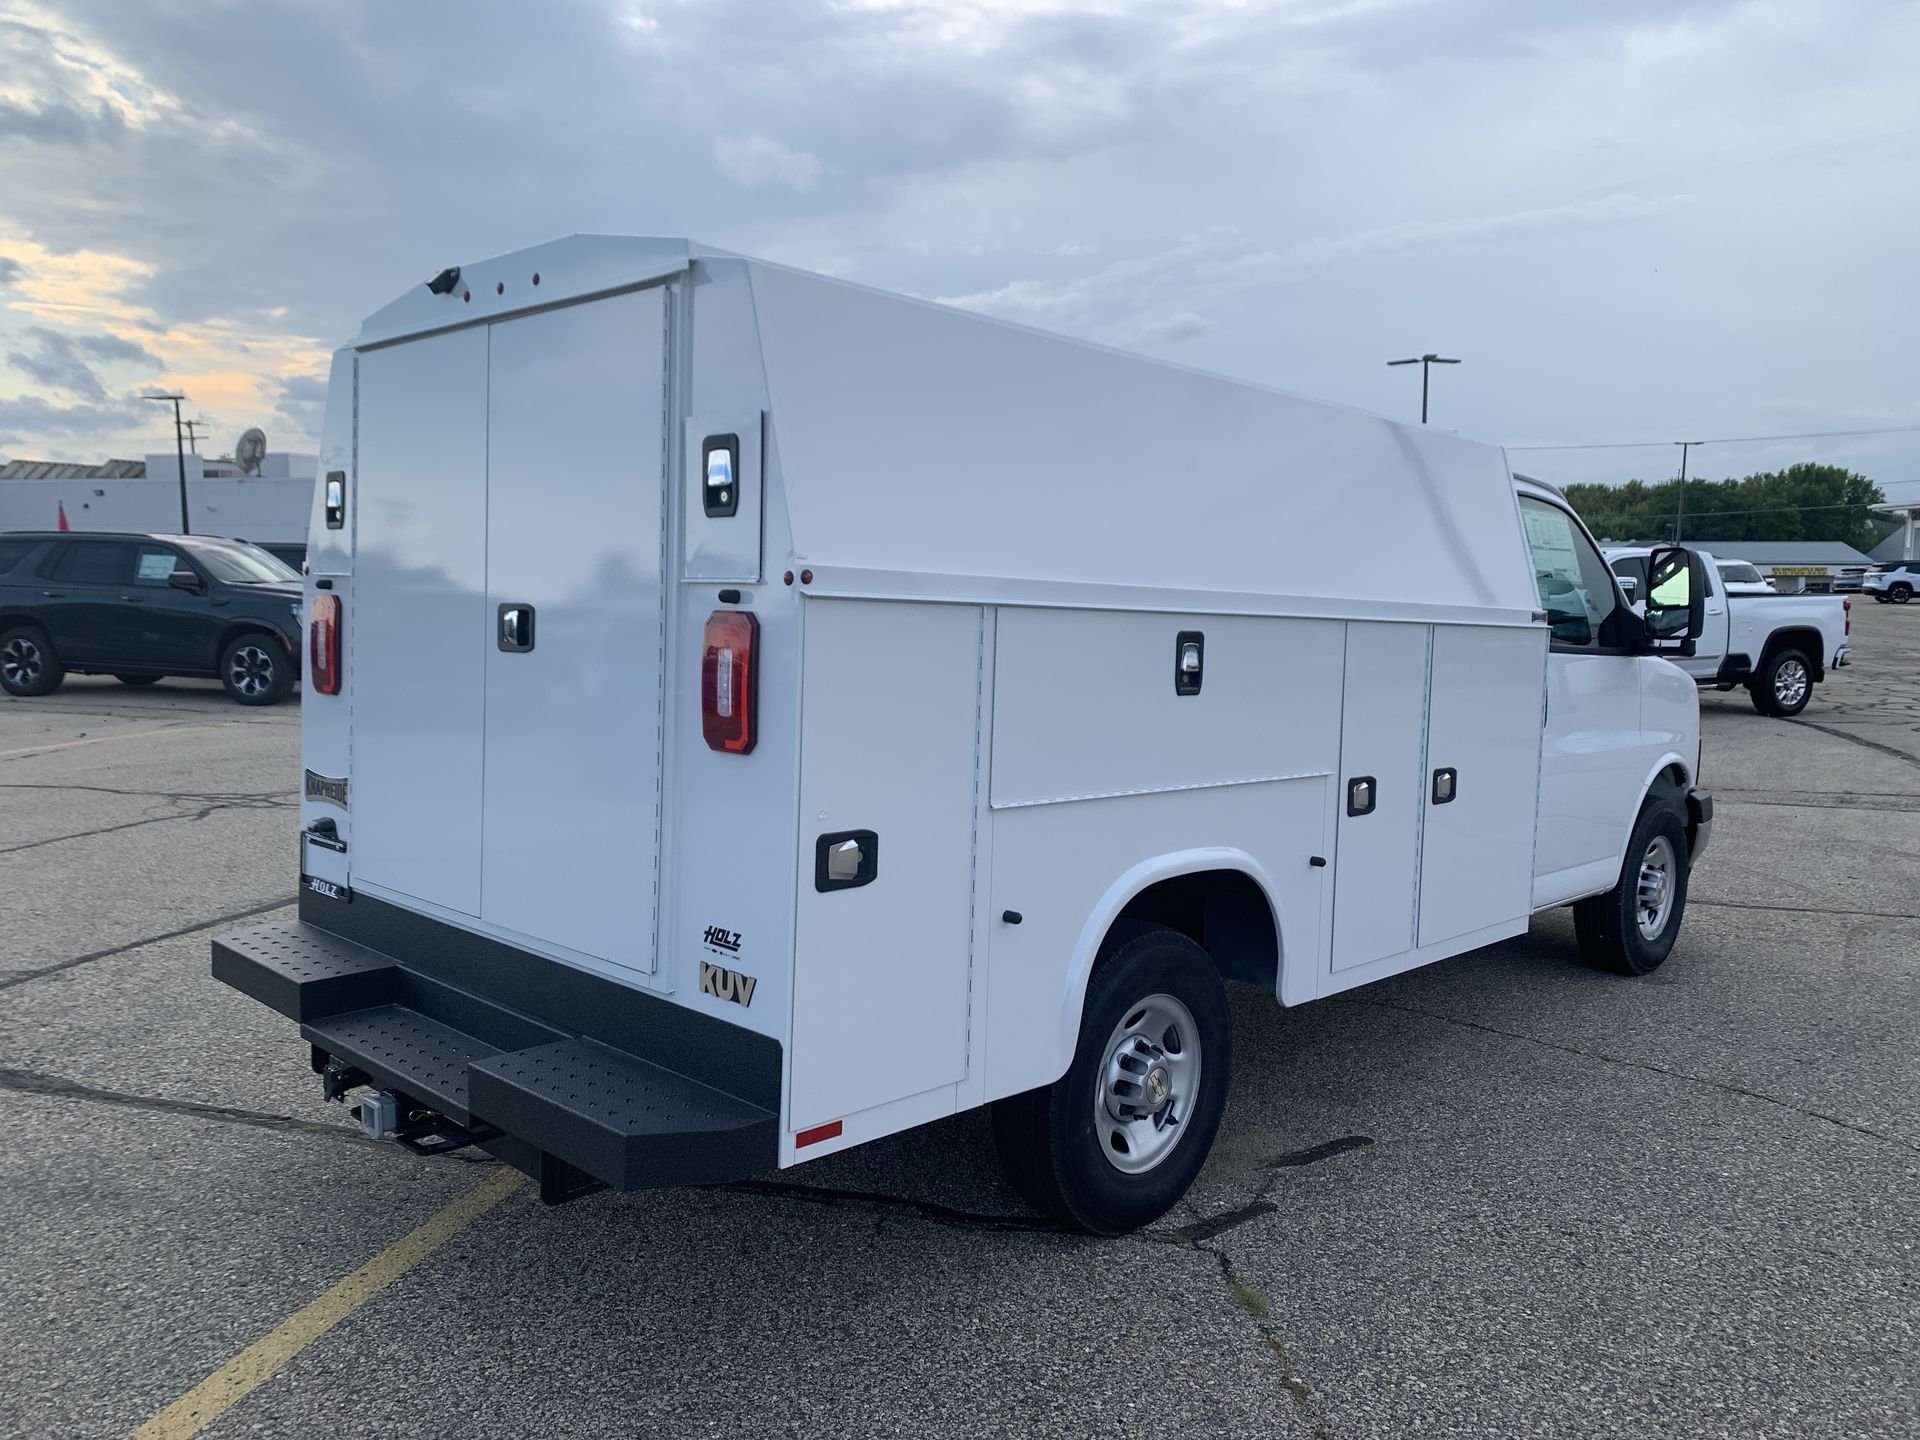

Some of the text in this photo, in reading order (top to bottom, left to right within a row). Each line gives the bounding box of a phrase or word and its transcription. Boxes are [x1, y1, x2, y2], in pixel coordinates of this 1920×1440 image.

[306, 773, 348, 807] KNAPHEIDE
[309, 878, 338, 898] HOLZ
[704, 925, 742, 951] HOLZ
[699, 961, 757, 1008] KUV
